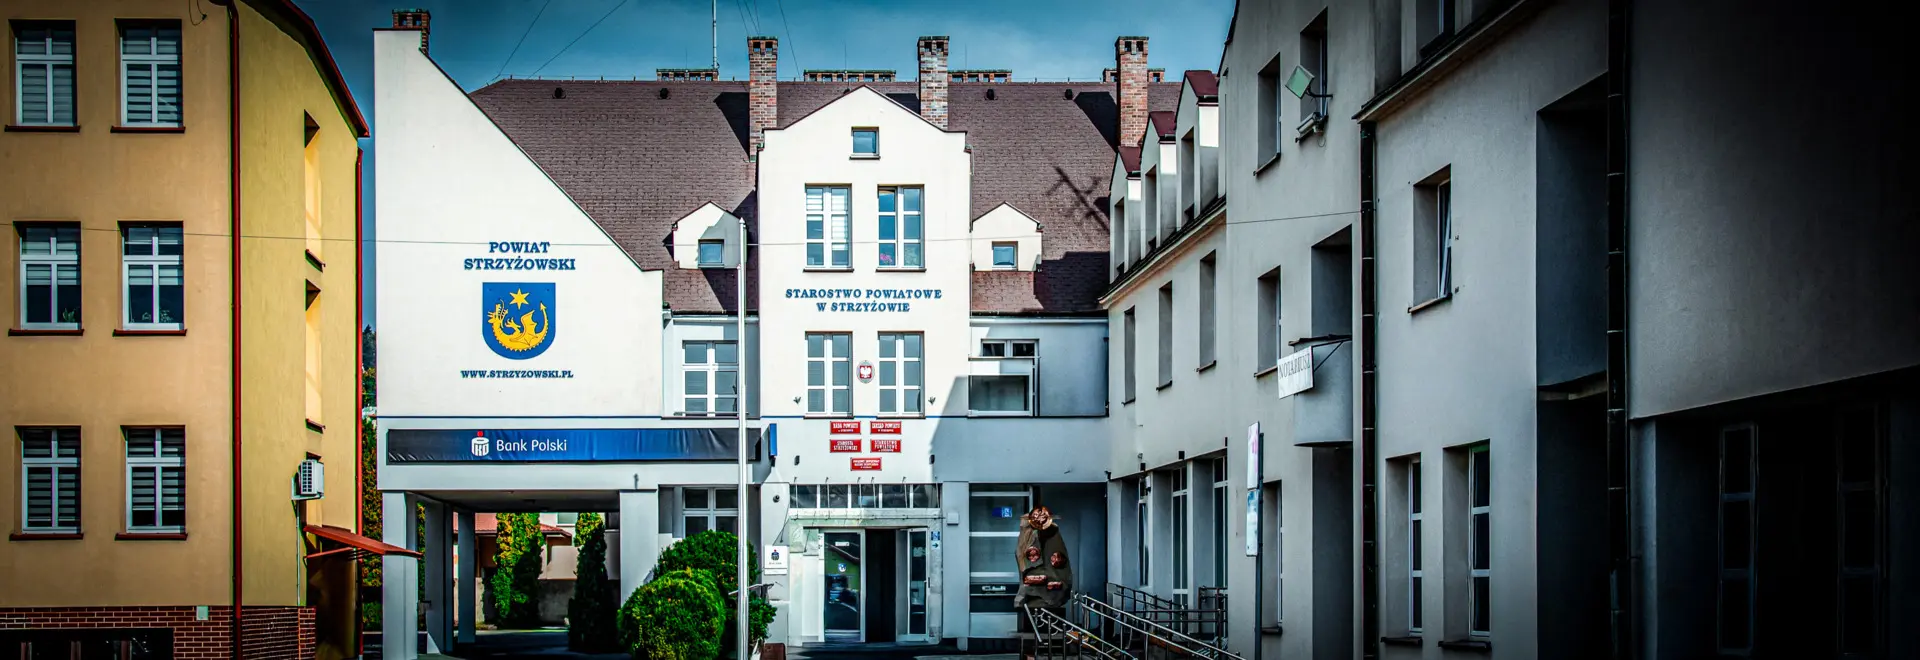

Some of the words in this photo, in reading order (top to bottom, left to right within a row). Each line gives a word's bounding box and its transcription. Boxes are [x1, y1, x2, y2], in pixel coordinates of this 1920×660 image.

[489, 241, 551, 254] POWIAT
[463, 255, 576, 271] STRZYŻOWSKI
[785, 288, 862, 299] STAROSTWO
[865, 289, 942, 299] POWIATOWE
[816, 302, 827, 312] W
[831, 300, 910, 312] STRZYŻOWIE
[460, 369, 574, 379] WWW.STRZYZOWSKI.PL
[496, 439, 528, 452] Bank
[531, 438, 567, 452] Polski
